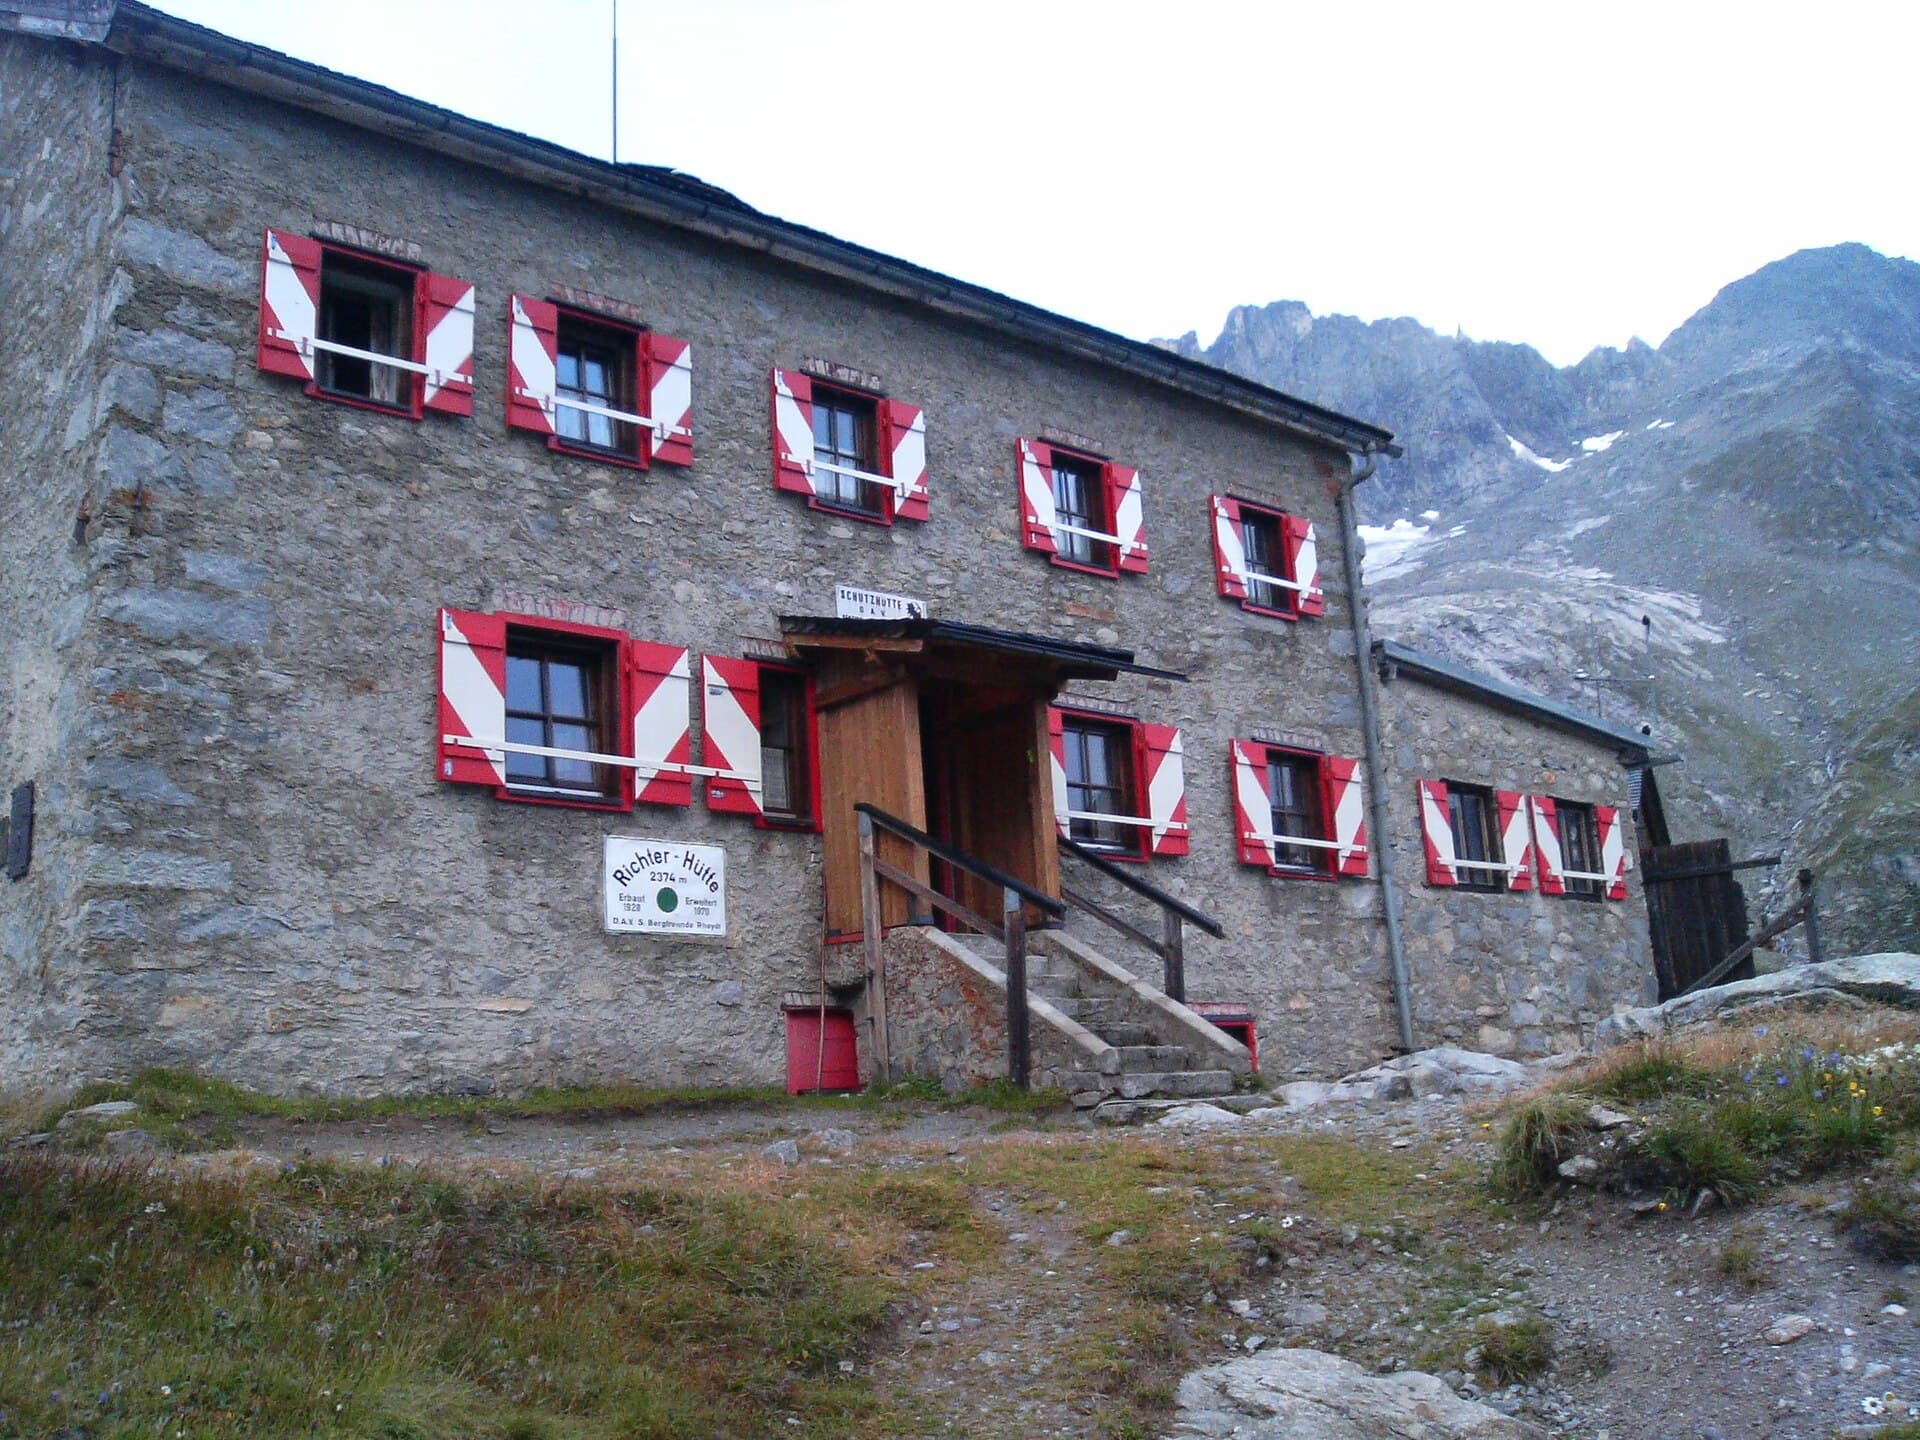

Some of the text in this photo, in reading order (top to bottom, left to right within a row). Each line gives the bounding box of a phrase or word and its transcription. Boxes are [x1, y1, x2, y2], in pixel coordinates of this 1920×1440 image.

[612, 848, 670, 887] Richter
[650, 871, 676, 883] 2374
[618, 893, 646, 903] Erbaut
